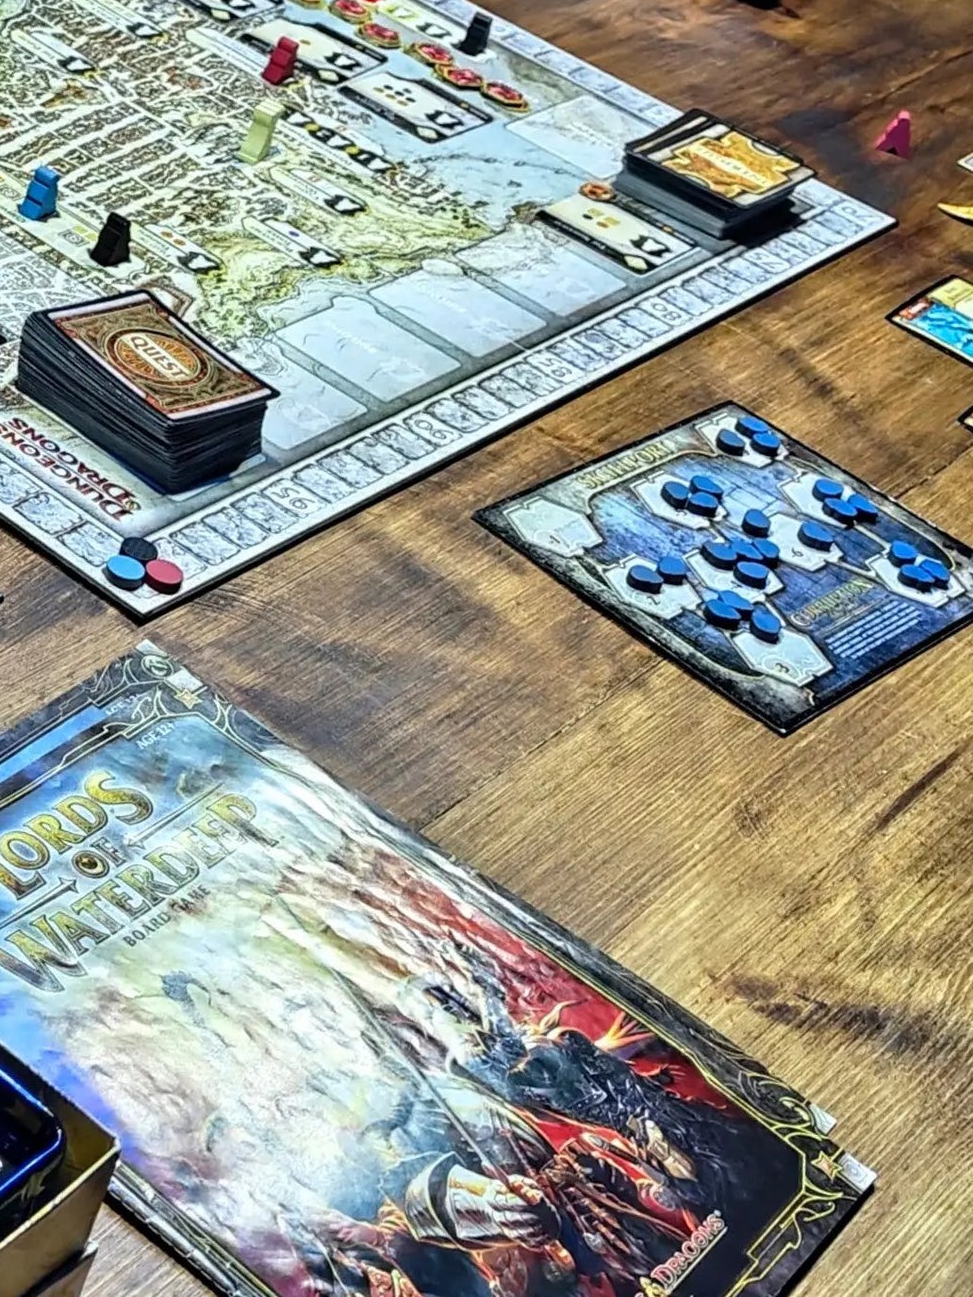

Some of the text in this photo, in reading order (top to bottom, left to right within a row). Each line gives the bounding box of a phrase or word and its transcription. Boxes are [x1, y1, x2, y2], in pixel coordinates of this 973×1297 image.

[650, 302, 682, 321] 80
[130, 335, 188, 379] QUEST
[540, 358, 572, 378] 85
[415, 420, 454, 440] 90
[7, 417, 137, 503] DRAGONS
[272, 487, 315, 510] 95
[136, 730, 158, 750] AGE
[70, 836, 128, 879] OF
[123, 884, 212, 948] BOARD GAME
[650, 1212, 725, 1290] DRAGONS
